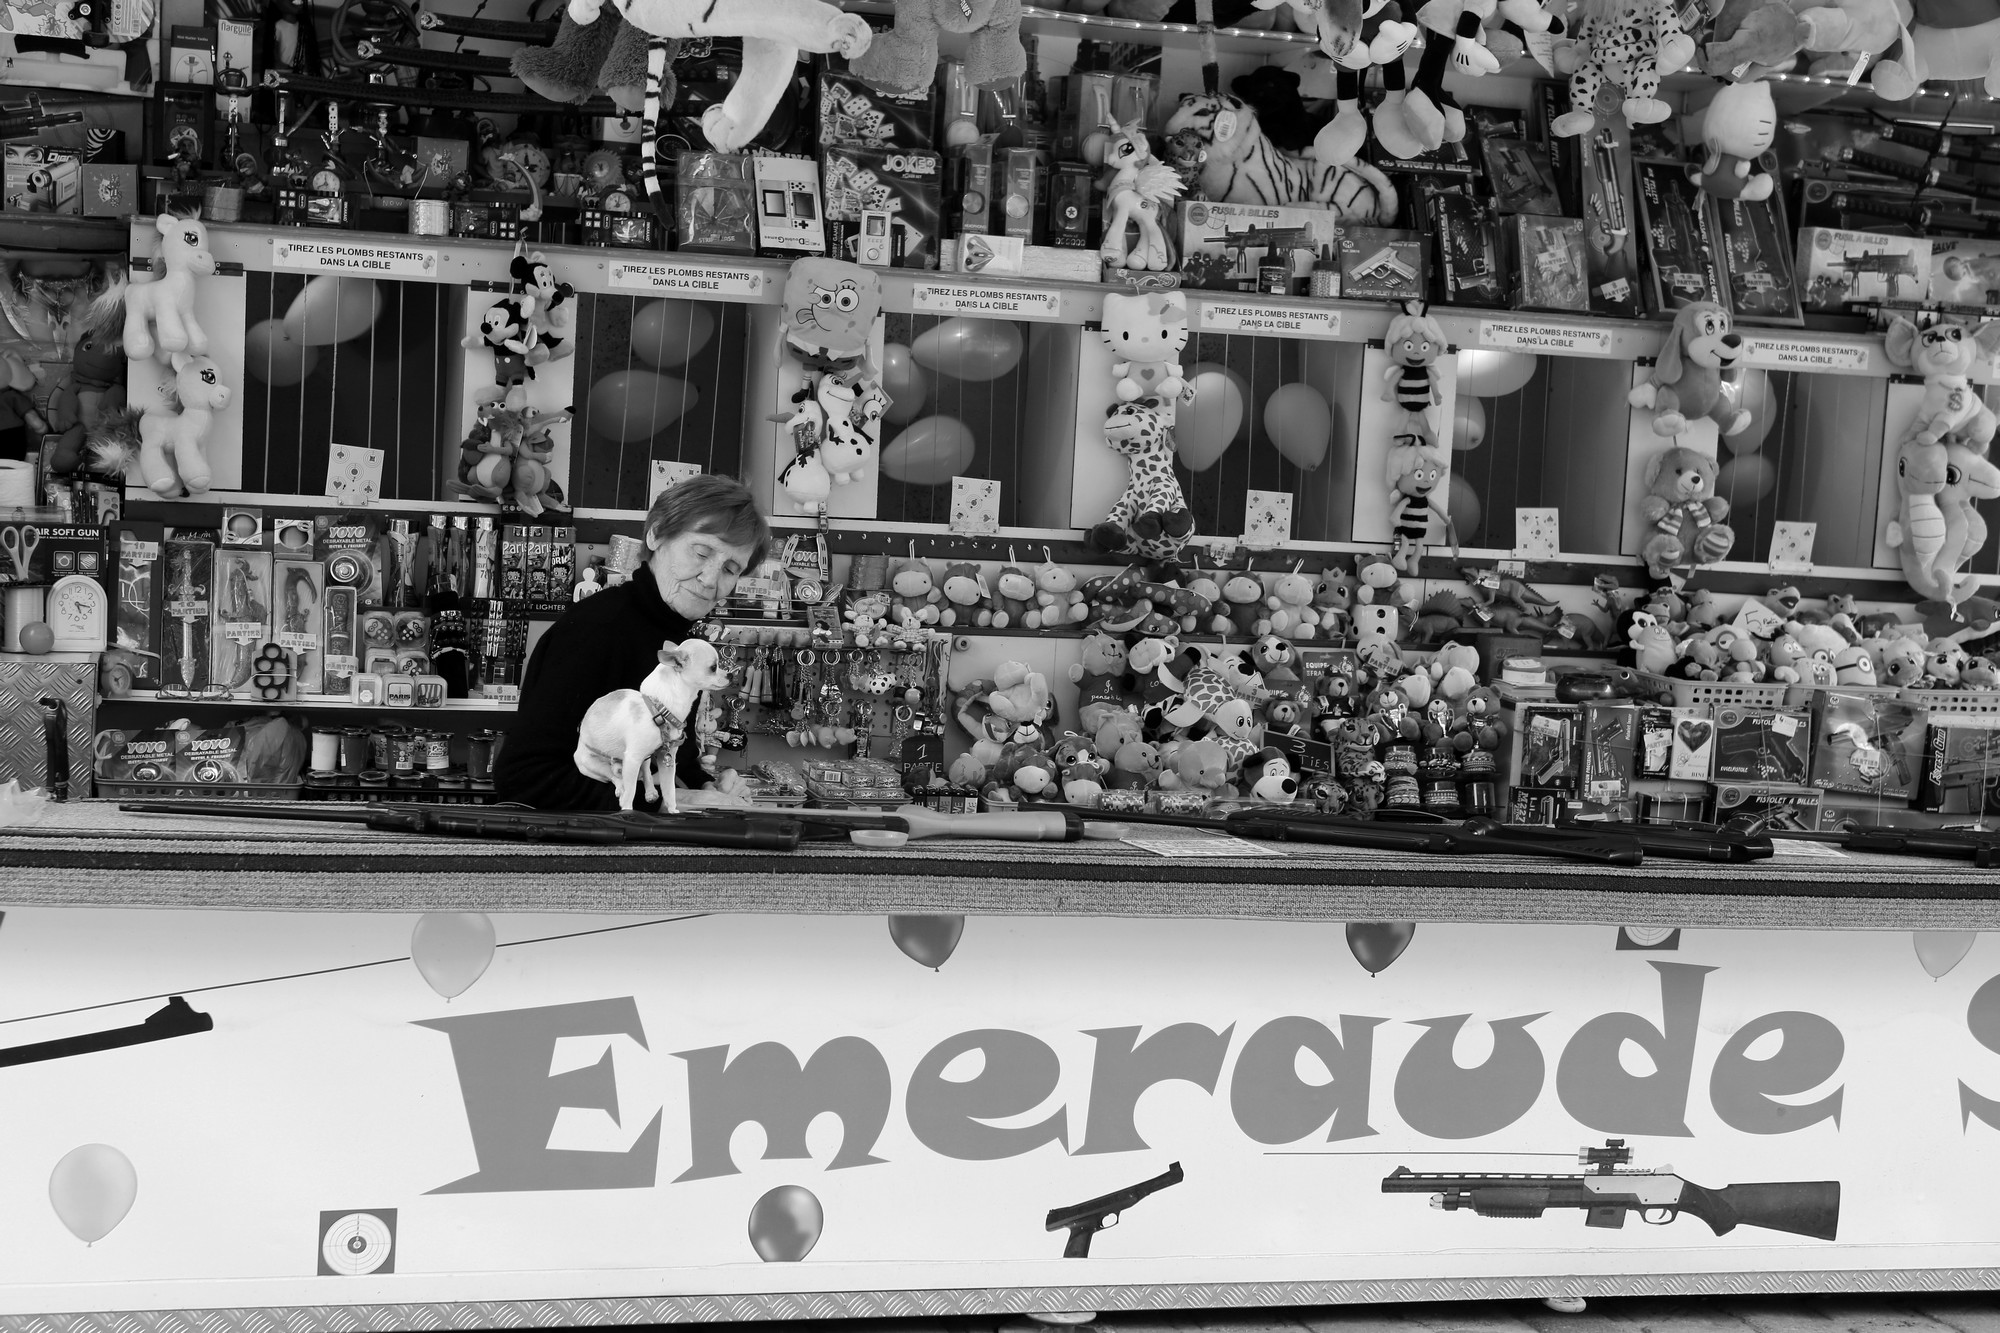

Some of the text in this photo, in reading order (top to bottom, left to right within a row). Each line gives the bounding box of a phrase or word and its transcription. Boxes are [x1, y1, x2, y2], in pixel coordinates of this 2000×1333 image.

[882, 154, 936, 175] JOKER
[1211, 206, 1279, 219] FUSIL A BILLES
[1834, 232, 1855, 242] FUSIL
[288, 244, 423, 261] TIREZ LES PLOMBS RESTANTS
[320, 258, 345, 267] DANS
[362, 260, 391, 270] CIBLE
[623, 265, 749, 280] TIREZ LES PLOMBS RESTANTS
[652, 278, 719, 290] DANS LA CIBLE
[927, 287, 1048, 302] TIREZ LES PLOMBS RESTANTS
[955, 300, 1018, 311] DANS LA CIBLE
[1214, 307, 1329, 321] TIREZ LES PLOMBS RESTANTS
[1241, 319, 1301, 329] DANS LA CIBLE
[1492, 324, 1600, 339] TIREZ LES PLOMBS RESTANTS
[1516, 336, 1574, 348] DANS LA CIBLE
[1754, 342, 1858, 356] TIREZ LES PLOMBS RESTANTS
[1778, 353, 1798, 362] DANS
[1810, 356, 1833, 364] CIBLE
[35, 528, 99, 537] AIR SOFT GUN
[329, 526, 366, 538] YOYO
[120, 550, 158, 559] PARTIES
[737, 585, 768, 595] PARTIES
[171, 608, 207, 616] PARTIES
[535, 603, 566, 611] LIGHTER
[1744, 610, 1762, 633] 5
[226, 629, 261, 638] PARTIES
[280, 639, 316, 648] PARTIES
[1369, 657, 1398, 675] PARTIES
[1252, 686, 1257, 695] 3
[1752, 718, 1775, 726] PISTOLE
[191, 738, 231, 751] YOYO
[1933, 729, 1947, 751] Gun
[127, 741, 166, 754] YOYO
[917, 743, 928, 760] 1
[1289, 739, 1306, 754] 3
[1756, 796, 1785, 804] PISTOLET
[1519, 791, 1529, 823] M227
[407, 960, 1846, 1196] Emeraude
